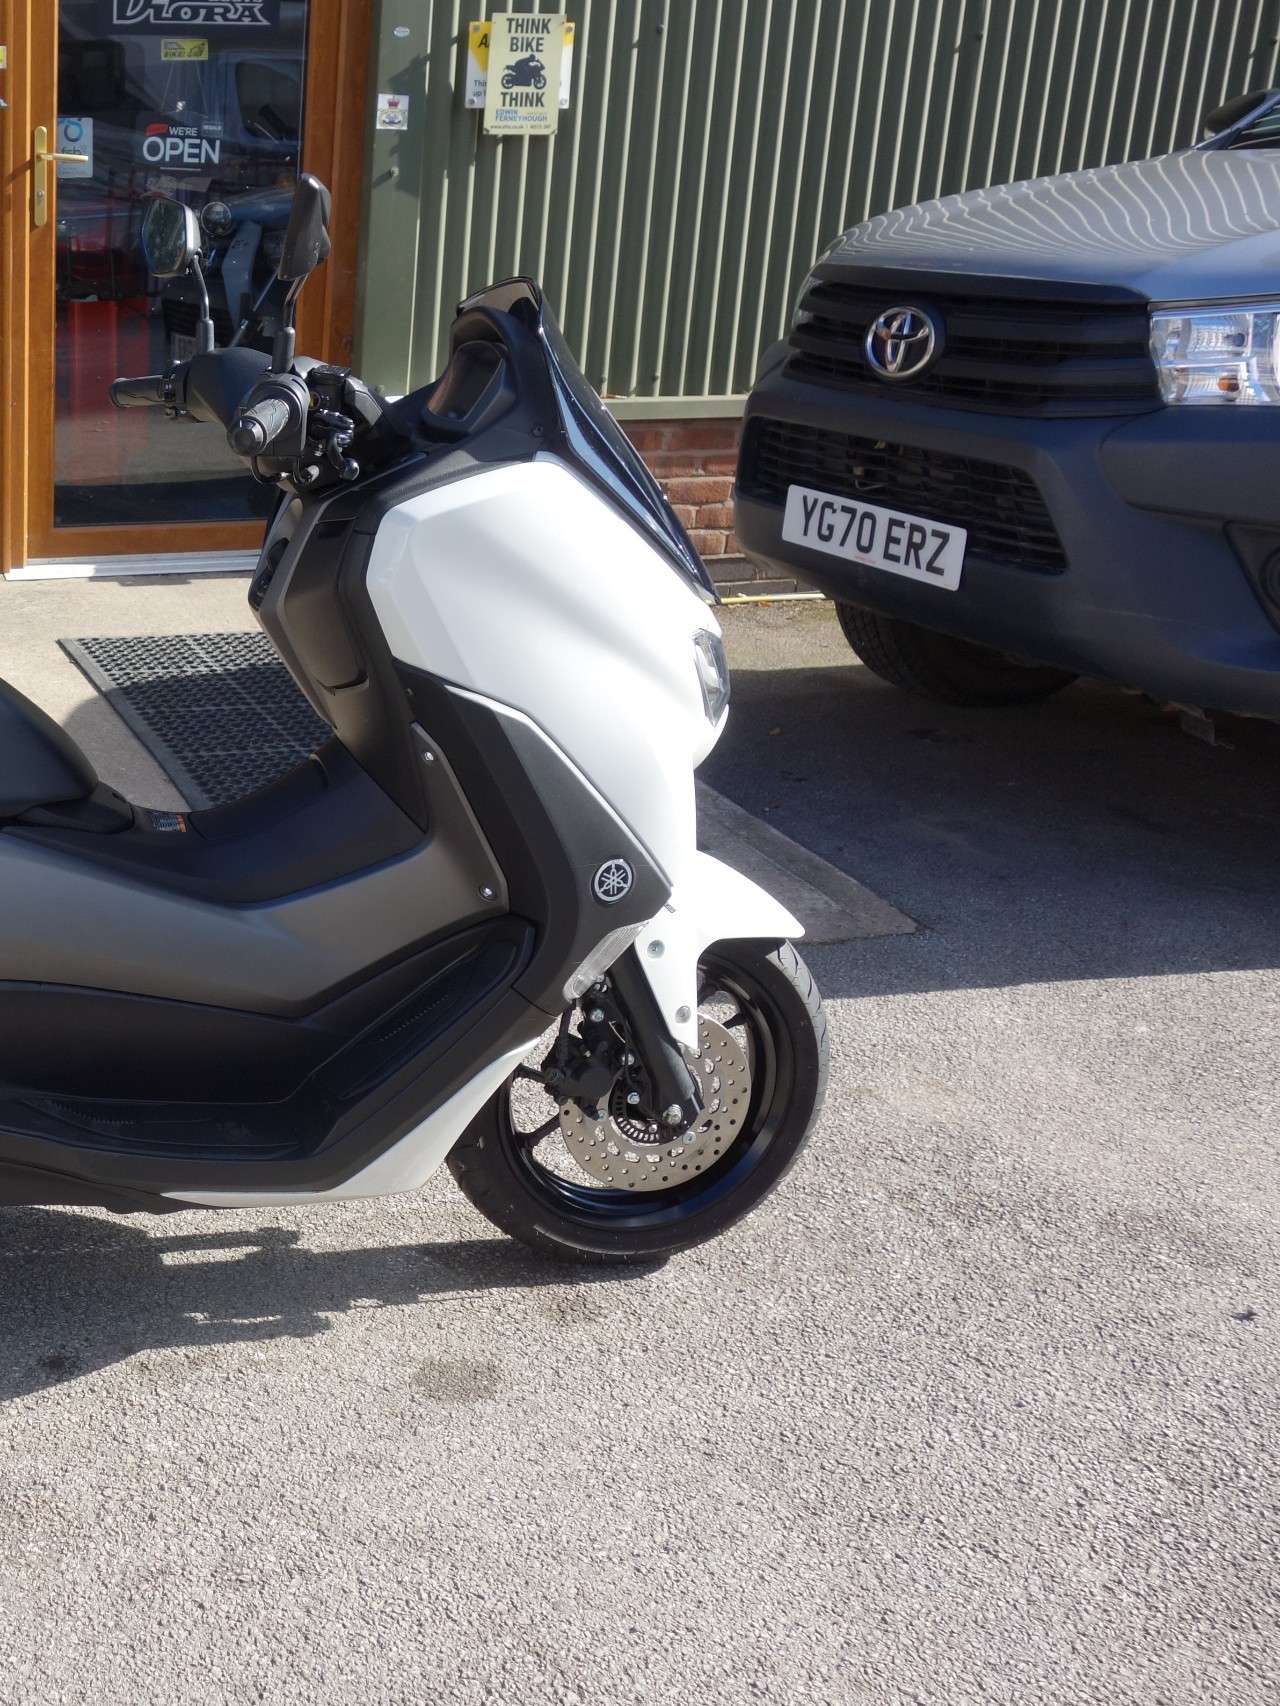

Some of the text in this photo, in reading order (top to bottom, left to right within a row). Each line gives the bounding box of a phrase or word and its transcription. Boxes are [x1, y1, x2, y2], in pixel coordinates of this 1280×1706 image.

[506, 18, 551, 34] THINK
[510, 37, 544, 53] BIKE
[501, 92, 545, 107] THINK
[143, 136, 220, 164] OPEN
[802, 495, 950, 576] YG70 ERZ
